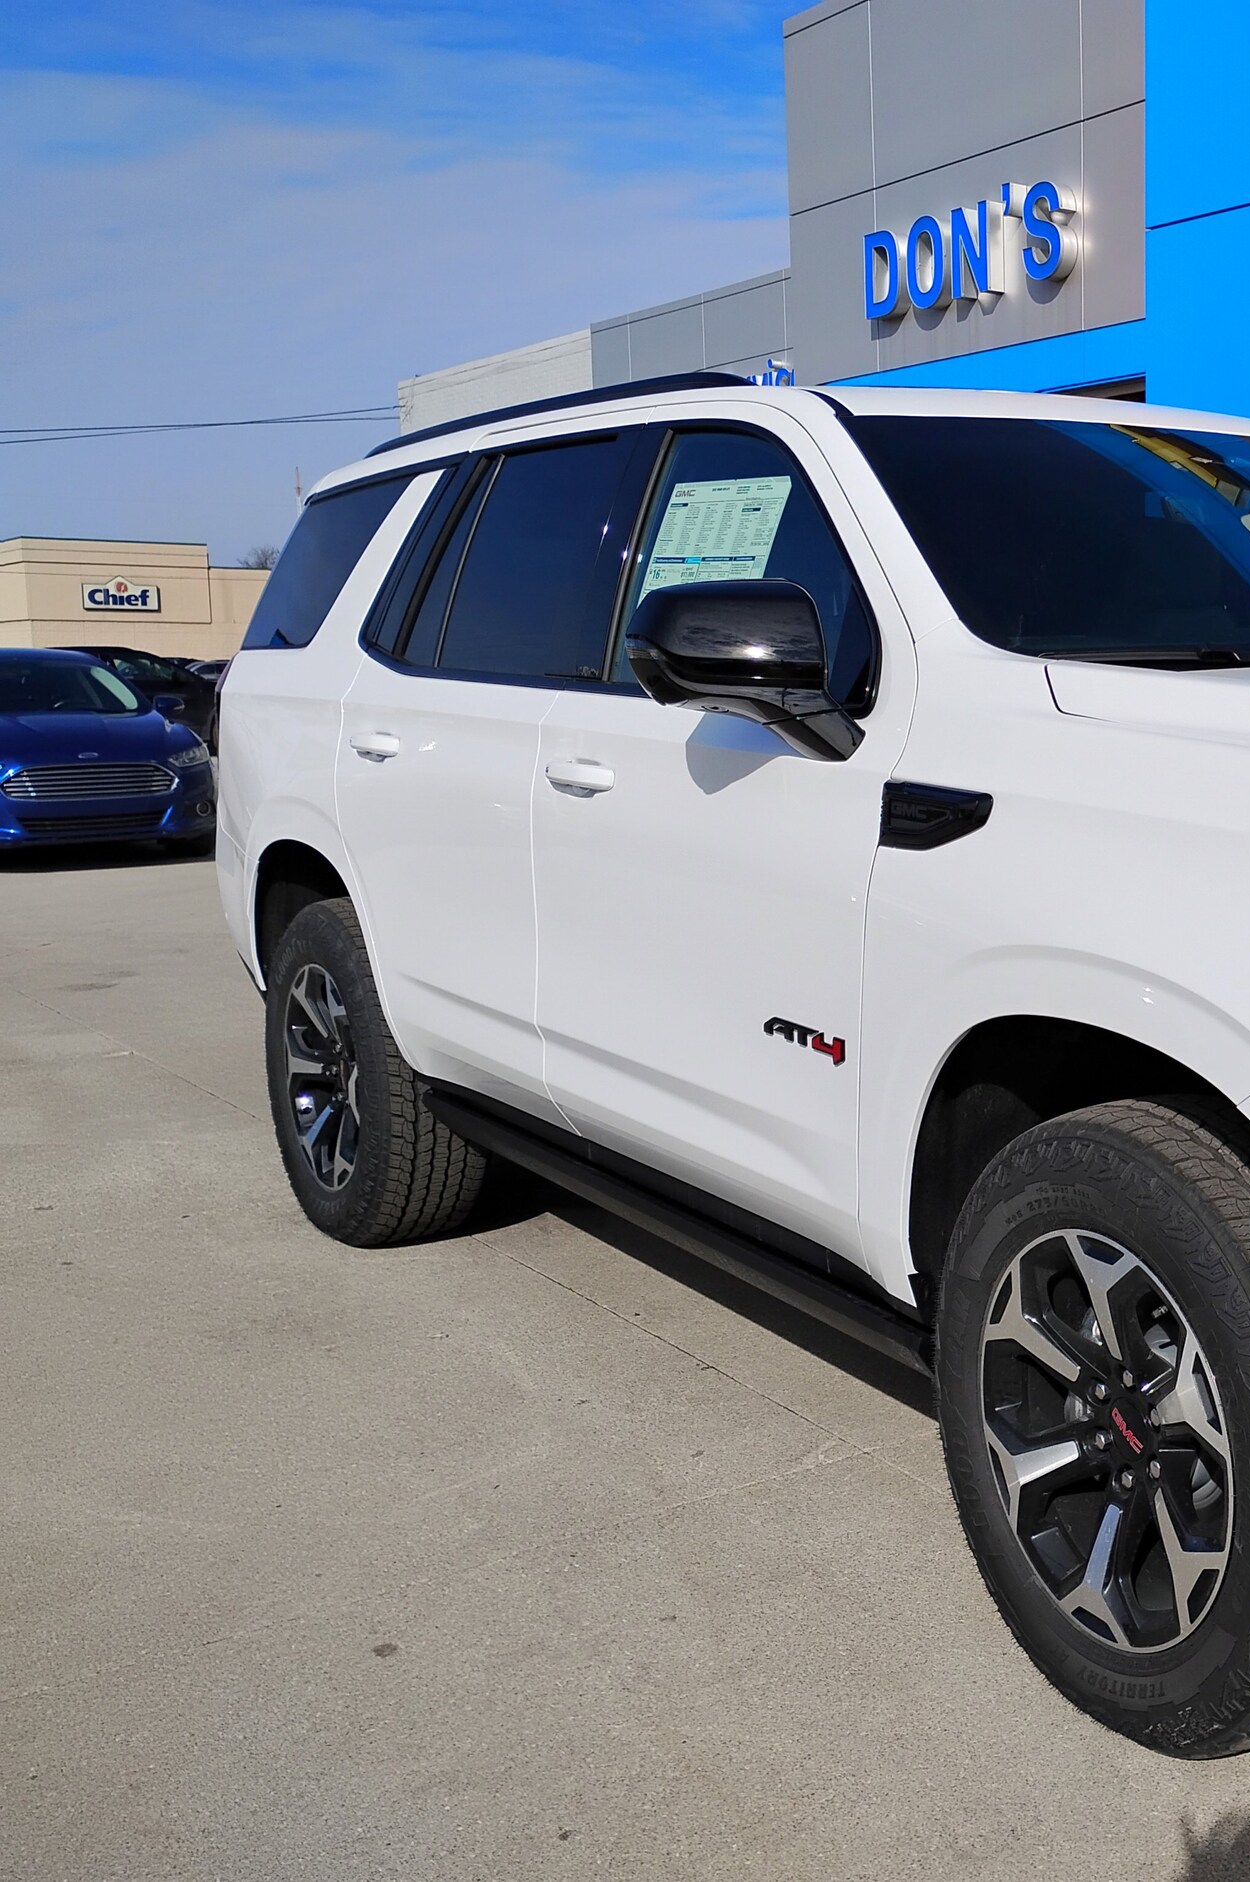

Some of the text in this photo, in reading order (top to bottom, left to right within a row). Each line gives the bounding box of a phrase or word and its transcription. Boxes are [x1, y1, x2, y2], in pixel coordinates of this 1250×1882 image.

[864, 181, 1066, 320] DON'S
[675, 489, 696, 498] GMC
[87, 588, 150, 607] Chief
[888, 801, 929, 820] GMC
[763, 1016, 847, 1067] AT4
[1111, 1407, 1145, 1455] GMC
